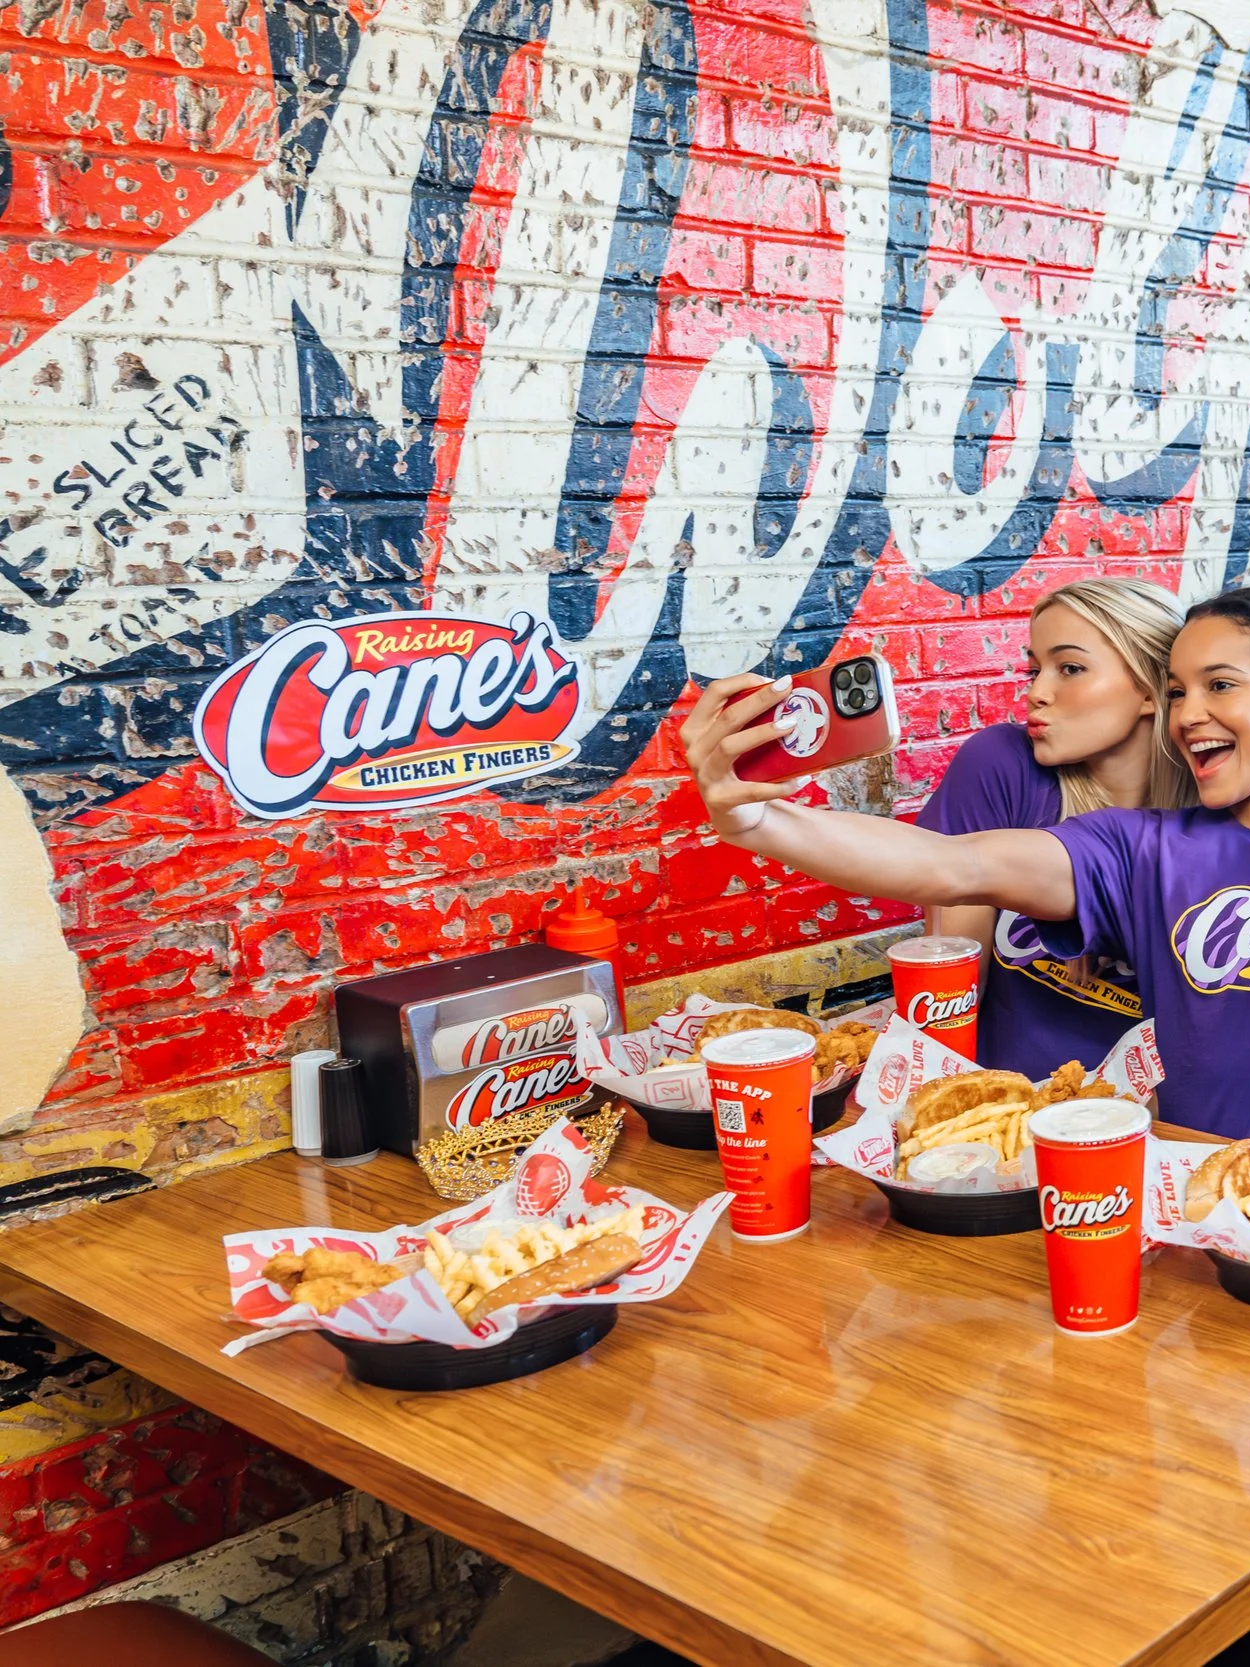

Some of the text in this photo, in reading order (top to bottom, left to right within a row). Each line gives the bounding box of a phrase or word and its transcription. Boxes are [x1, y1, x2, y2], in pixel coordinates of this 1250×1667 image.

[53, 374, 211, 510] SLICED
[355, 624, 474, 663] Raising
[226, 611, 577, 804] Cane's
[360, 744, 551, 788] CHICKEN FINGERS
[908, 983, 978, 1030] Cane's
[936, 989, 967, 1001] Raising
[1102, 986, 1143, 1012] FINGE
[507, 1010, 551, 1029] Raising
[507, 1056, 556, 1080] Raising
[910, 1039, 925, 1071] LOVE
[544, 1096, 582, 1112] FINGERS
[714, 1079, 739, 1093] THE
[741, 1084, 773, 1101] APP
[726, 1136, 742, 1148] the
[744, 1138, 768, 1149] line
[1062, 1190, 1104, 1202] Raising
[1160, 1161, 1176, 1202] LOVE
[1039, 1185, 1134, 1232] Cane's
